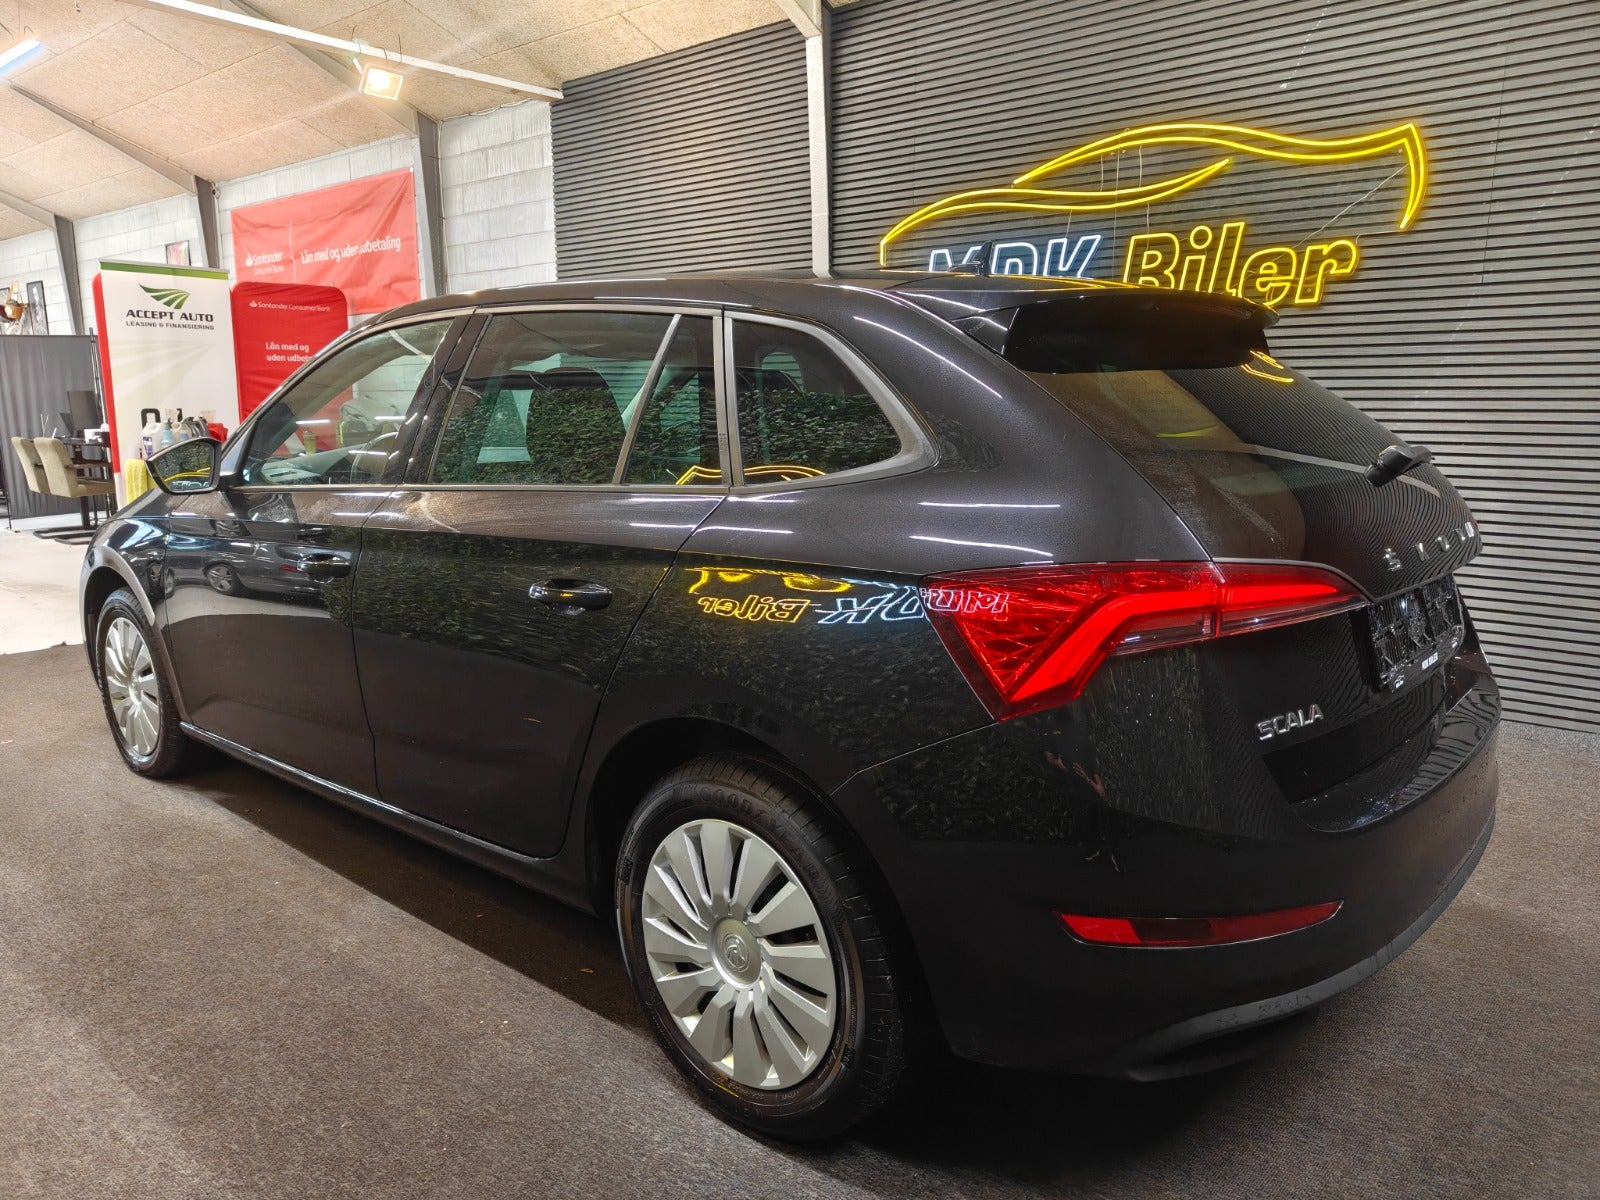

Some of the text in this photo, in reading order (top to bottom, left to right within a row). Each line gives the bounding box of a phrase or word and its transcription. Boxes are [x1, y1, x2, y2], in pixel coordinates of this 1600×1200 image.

[329, 248, 340, 262] og
[1121, 221, 1359, 307] Biler
[257, 301, 288, 310] Santander
[125, 309, 214, 322] ACCEPT AUTO
[165, 322, 215, 330] FINANSIERING
[265, 341, 310, 353] Lån med og
[266, 353, 286, 362] uden
[1256, 703, 1325, 741] SCALA
